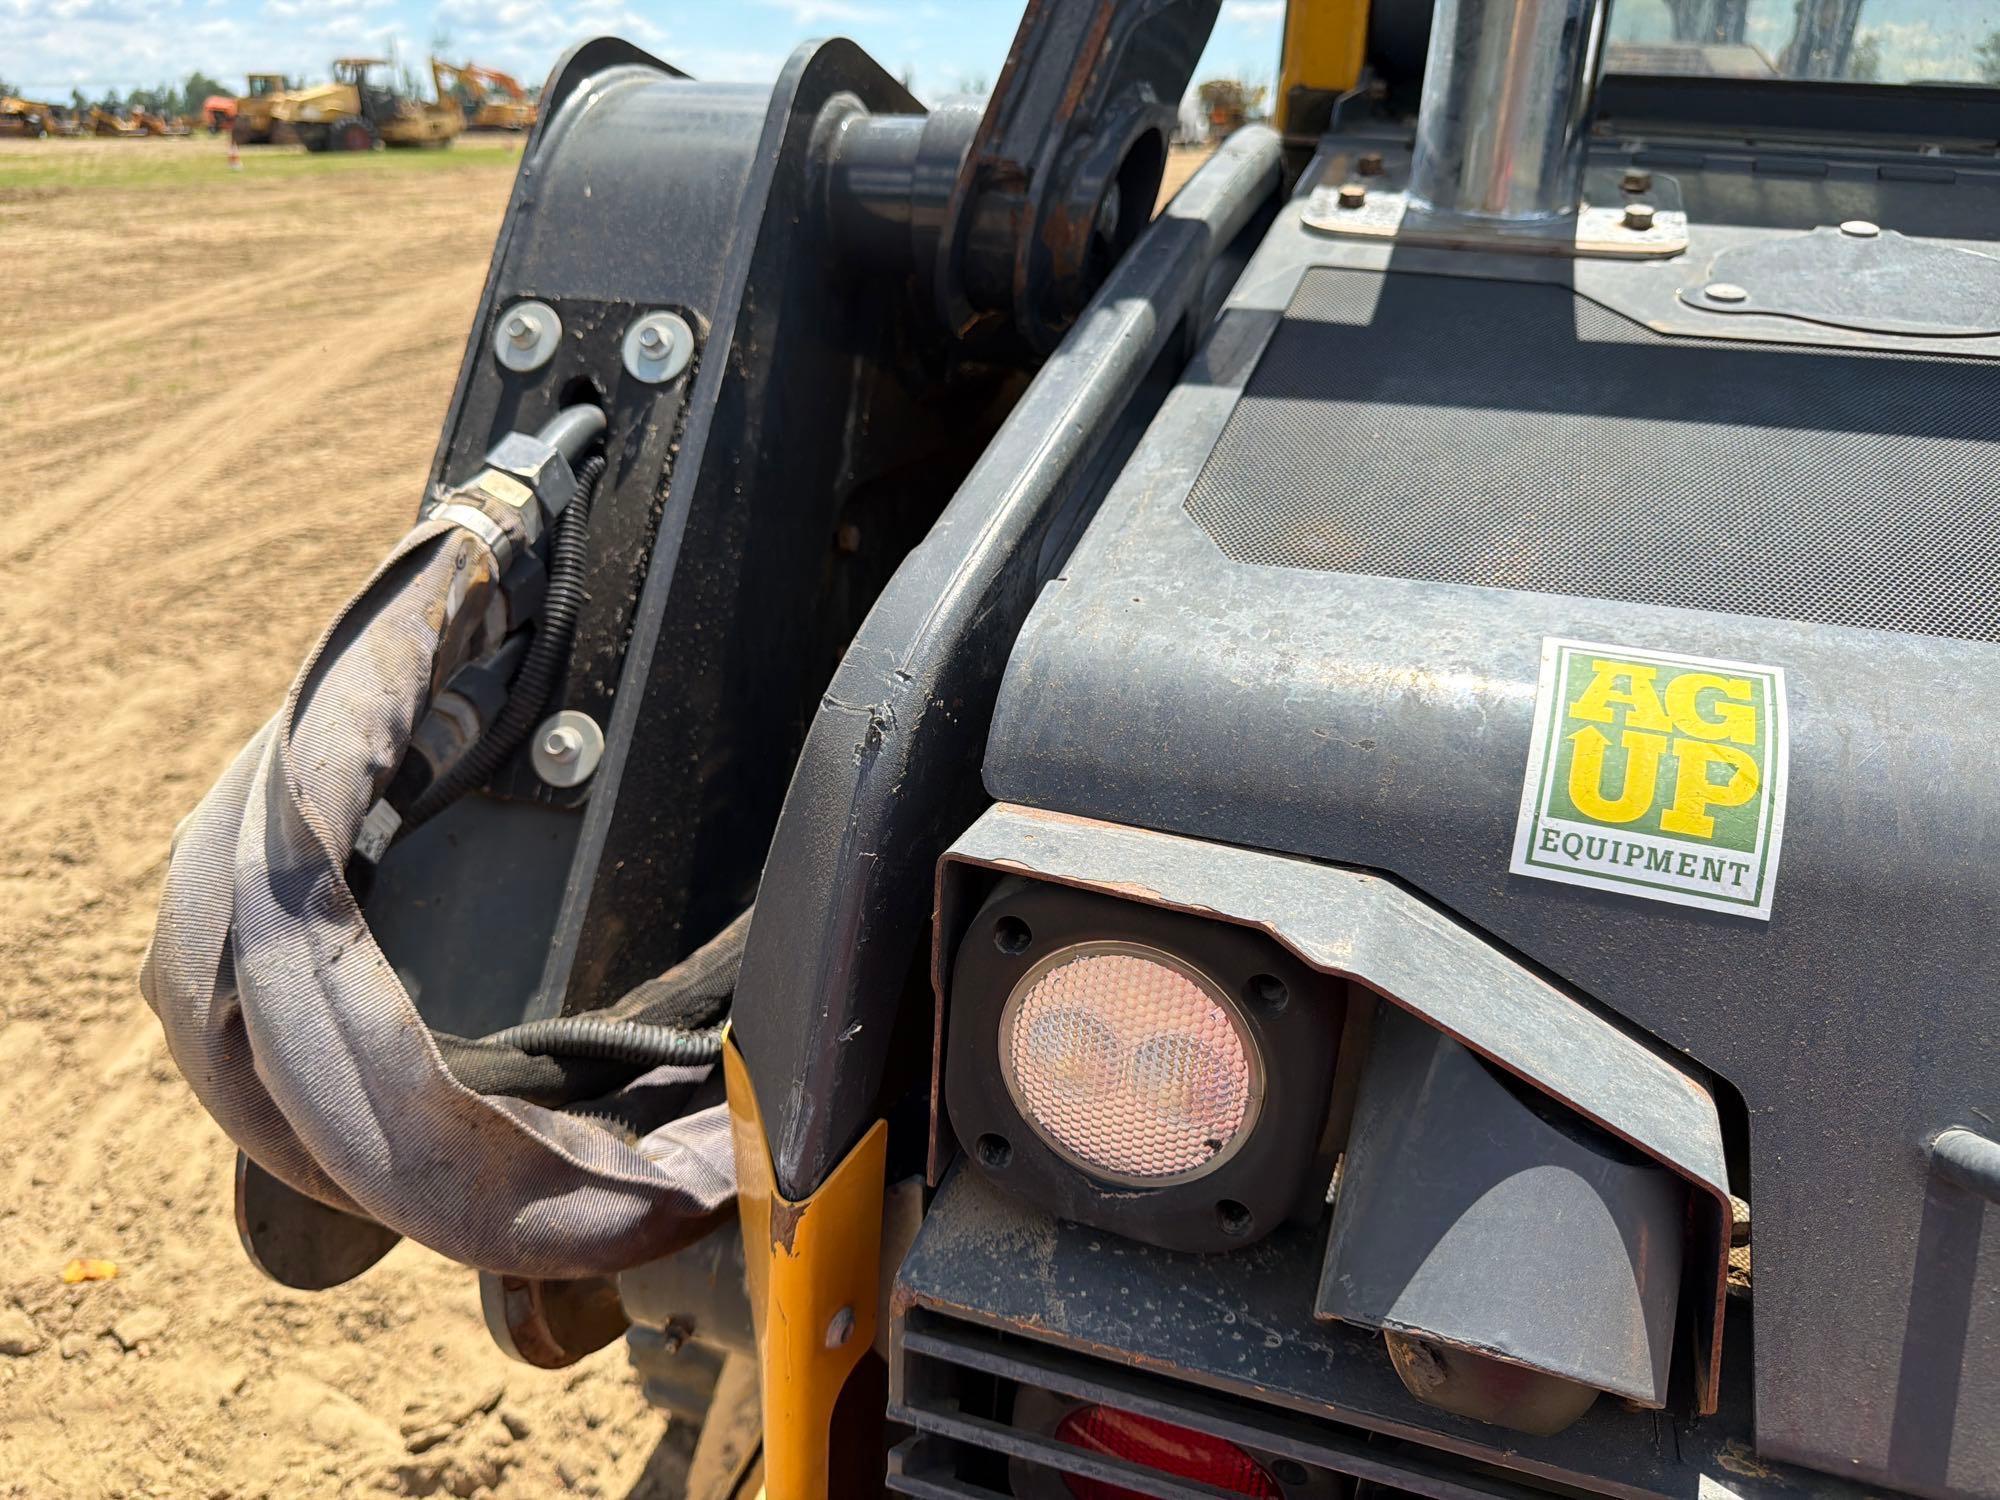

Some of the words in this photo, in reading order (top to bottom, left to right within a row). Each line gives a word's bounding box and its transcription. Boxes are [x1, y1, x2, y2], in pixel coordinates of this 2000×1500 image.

[1568, 660, 1756, 745] AG
[1567, 725, 1760, 838] UP
[1539, 828, 1750, 886] EQUIPMENT
